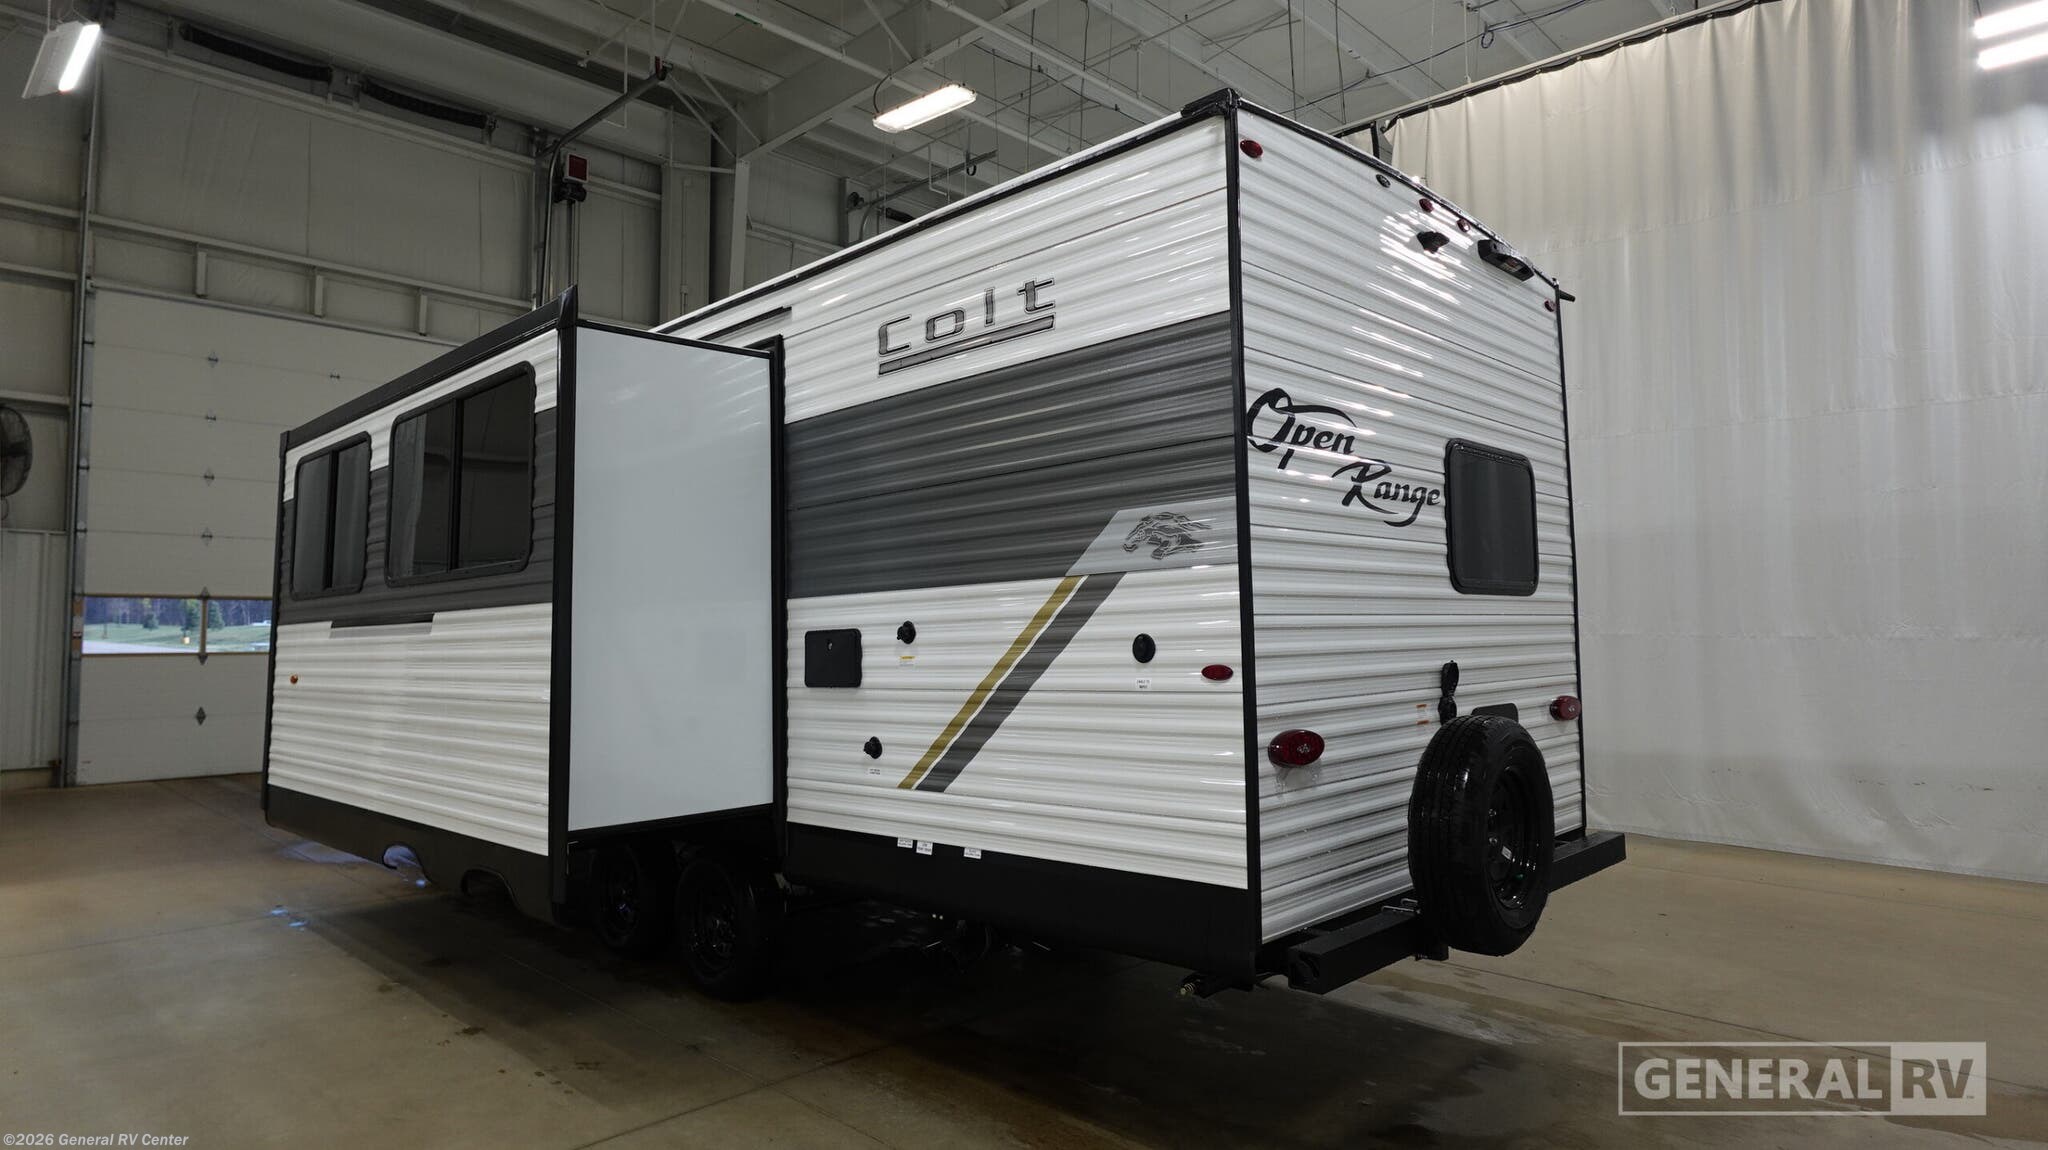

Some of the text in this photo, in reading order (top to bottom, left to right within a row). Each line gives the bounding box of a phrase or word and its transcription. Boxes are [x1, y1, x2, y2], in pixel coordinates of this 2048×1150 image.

[878, 278, 1055, 356] Colt
[1246, 387, 1357, 470] Open
[1331, 459, 1441, 527] Range
